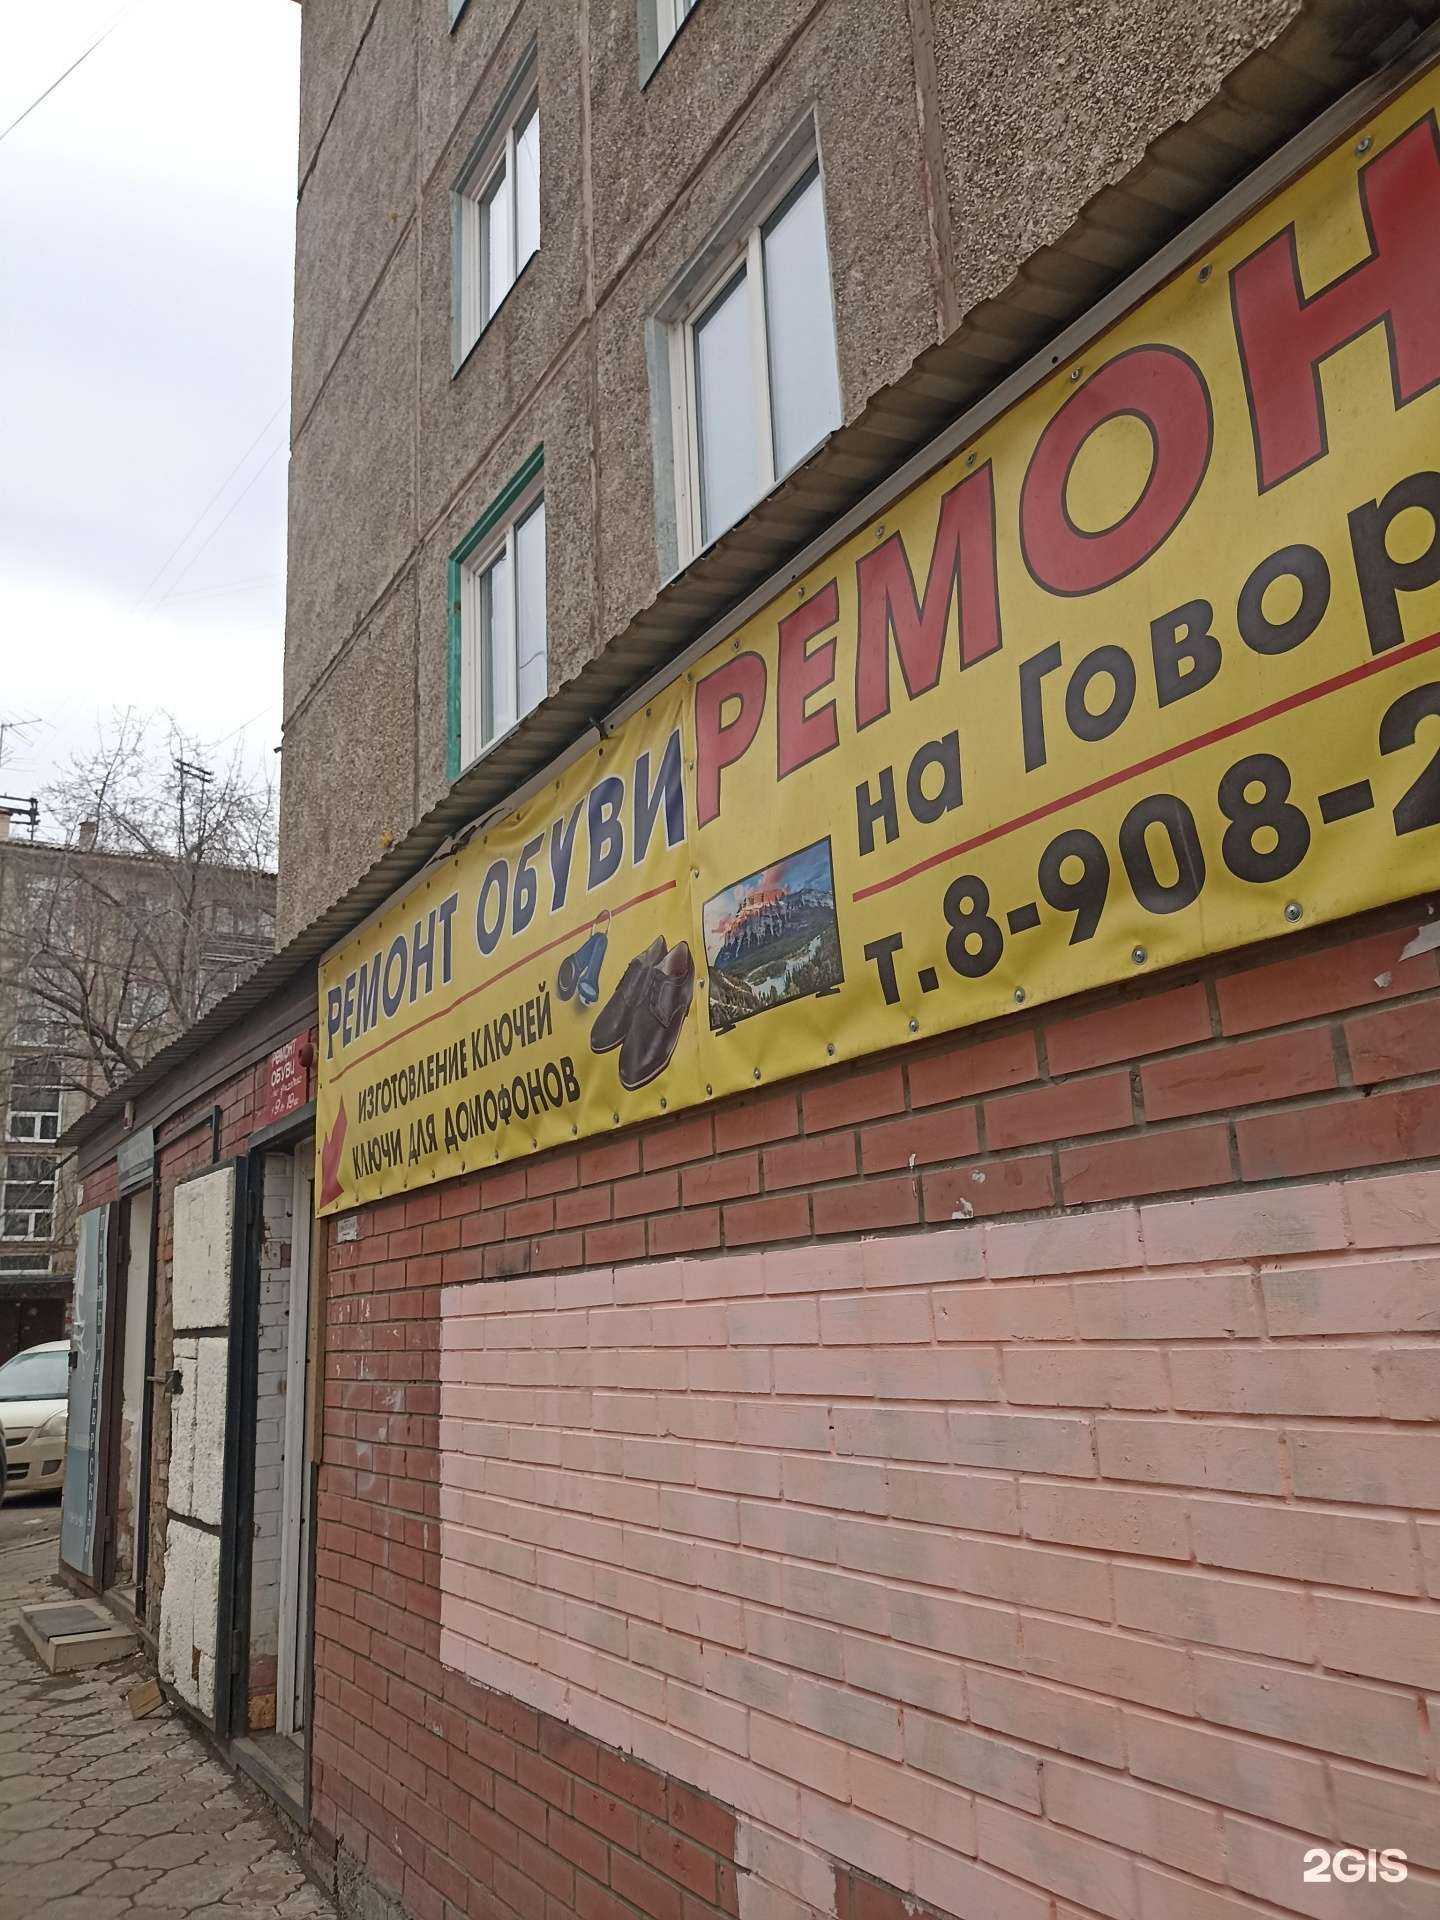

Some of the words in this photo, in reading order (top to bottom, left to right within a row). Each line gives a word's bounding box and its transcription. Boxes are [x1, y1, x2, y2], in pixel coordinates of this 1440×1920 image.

[695, 109, 1440, 829] РЕМОН
[855, 730, 964, 857] на
[1019, 470, 1440, 774] Говор
[326, 891, 459, 1061] РЕМОНТ
[475, 728, 686, 956] ОБУВИ
[358, 1038, 468, 1124] ИЗГОТОВЛЕНИЕ
[471, 980, 553, 1071] КЛЮЧЕЙ
[352, 1127, 404, 1180] КЛЮЧИ
[408, 1113, 438, 1167] ДЛЯ
[444, 1055, 581, 1154] ДОМОФОНОВ
